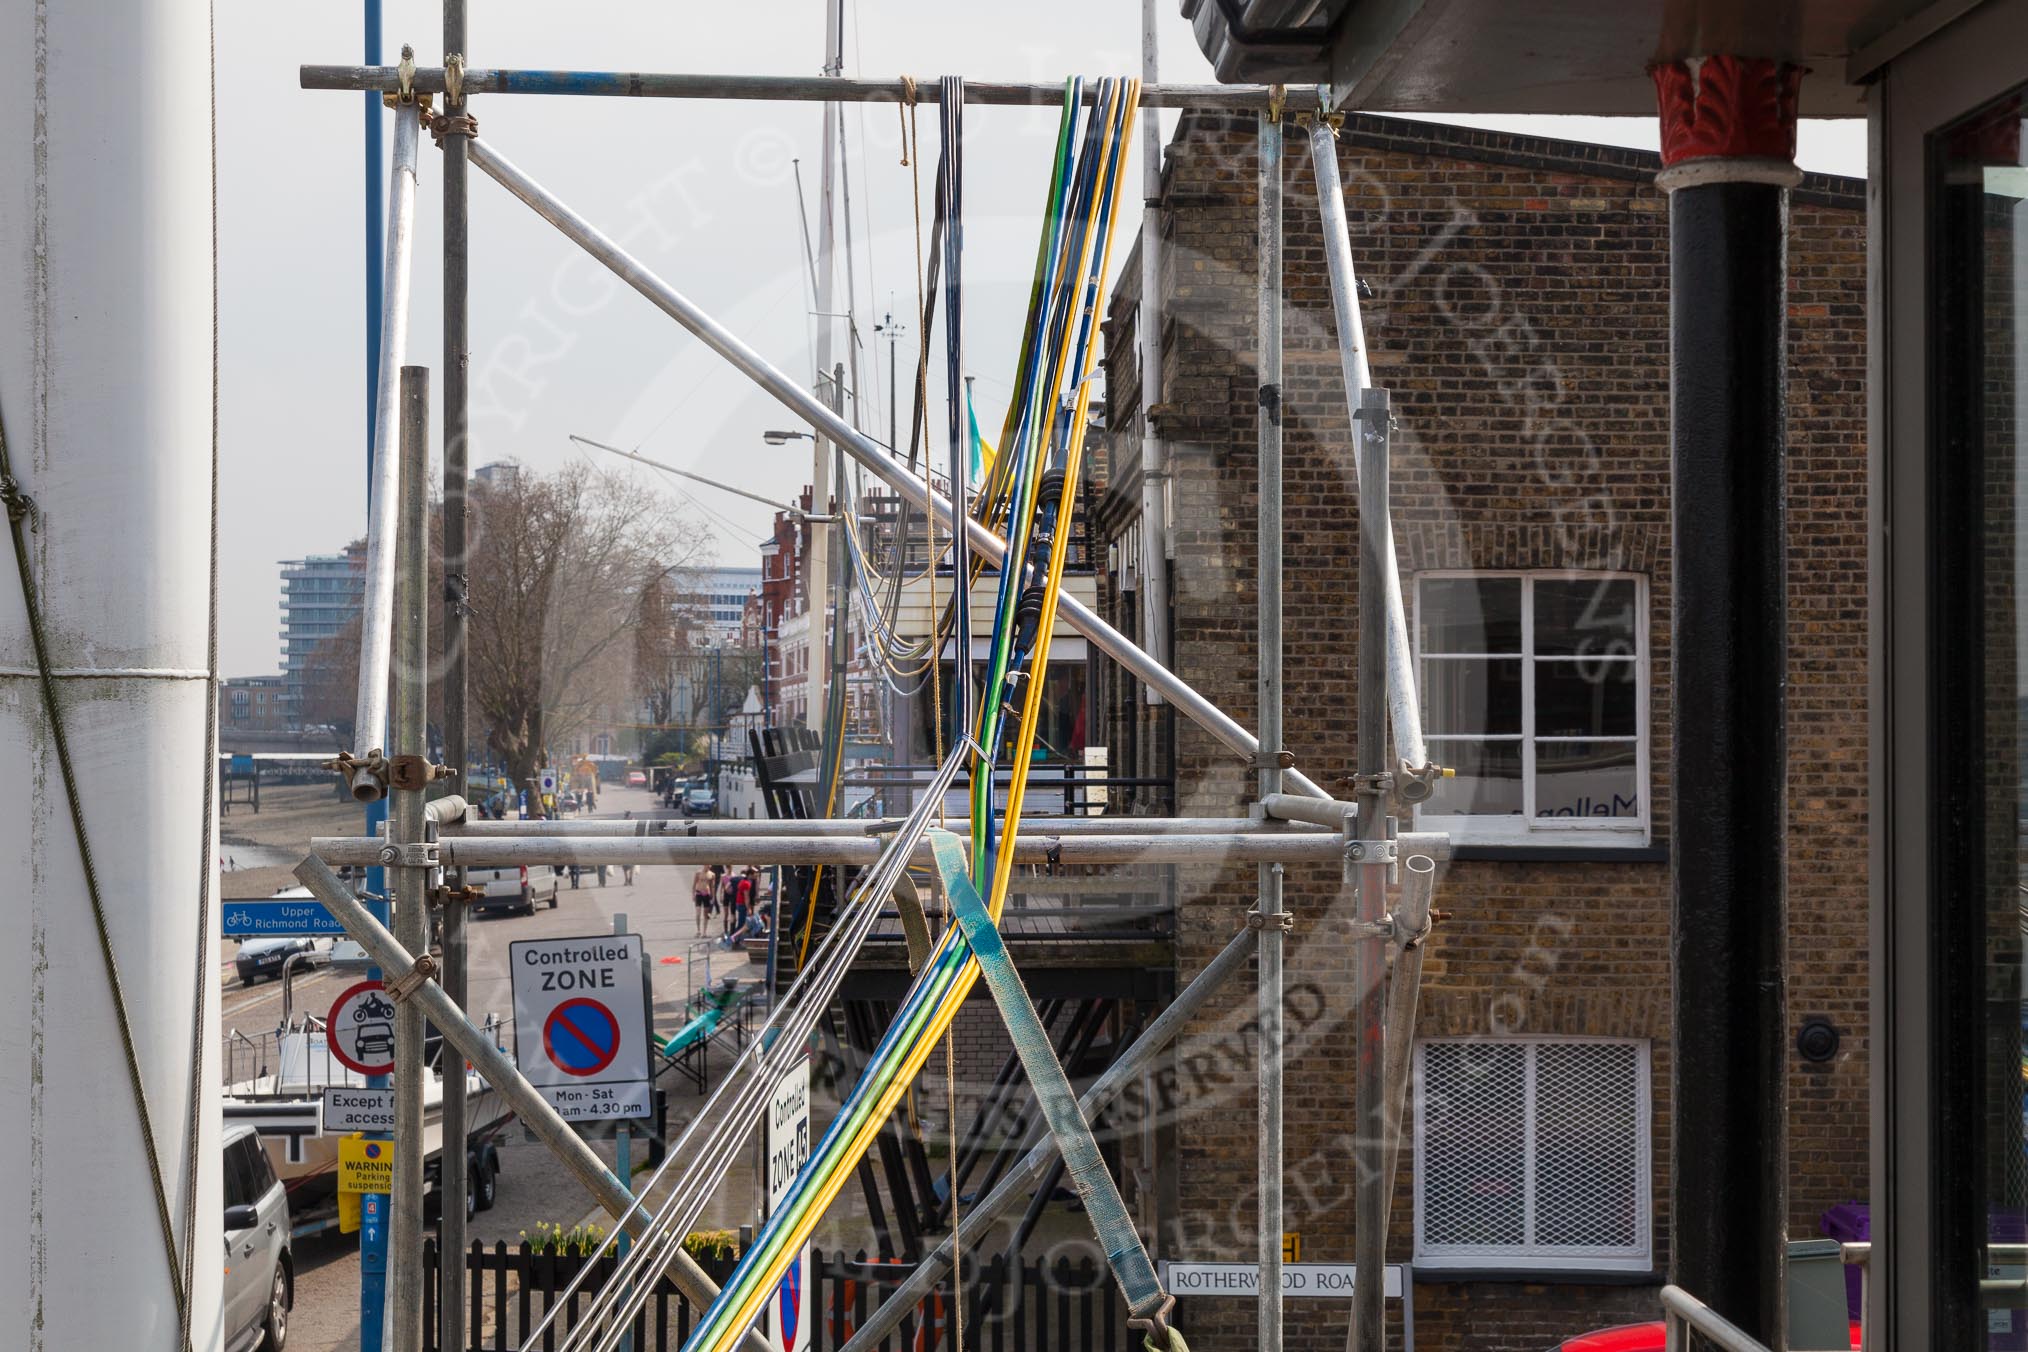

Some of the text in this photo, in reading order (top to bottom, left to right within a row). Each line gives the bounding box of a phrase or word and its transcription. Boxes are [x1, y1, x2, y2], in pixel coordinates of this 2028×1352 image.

[281, 906, 315, 918] Upper
[255, 918, 308, 929] Richmond
[525, 944, 628, 966] Controlled
[541, 968, 615, 992] ZONE
[333, 1094, 383, 1110] Except
[556, 1090, 582, 1102] Mon
[592, 1088, 614, 1100] Sat
[563, 1107, 581, 1117] am
[590, 1102, 620, 1114] 4.30
[623, 1103, 642, 1115] pm
[775, 1077, 805, 1130] Controlled
[345, 1161, 393, 1171] WARNIN
[772, 1138, 794, 1194] ZONE
[356, 1172, 390, 1182] Parking
[348, 1181, 392, 1191] suspensio
[1176, 1271, 1355, 1289] ROTHERWOD ROA
